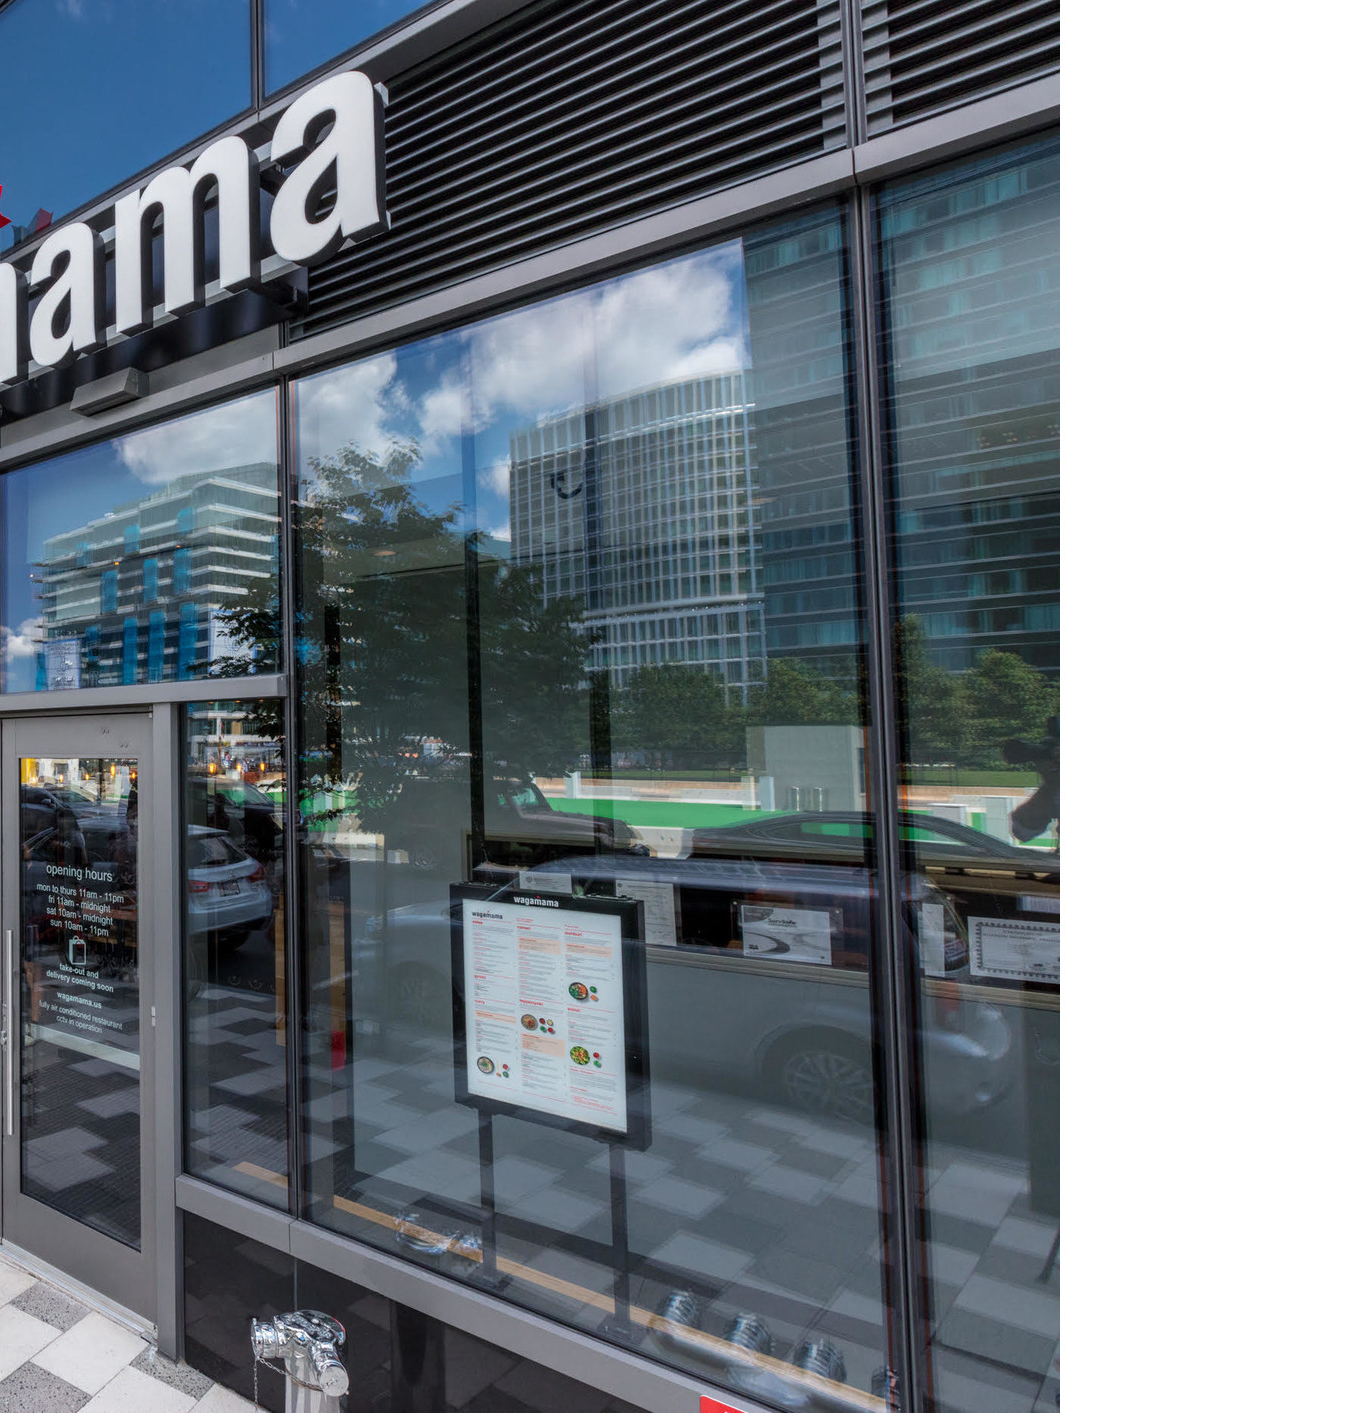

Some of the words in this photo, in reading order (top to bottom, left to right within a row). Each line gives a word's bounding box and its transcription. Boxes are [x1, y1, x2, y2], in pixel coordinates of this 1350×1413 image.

[47, 865, 82, 880] opening
[86, 867, 113, 882] hours
[37, 883, 50, 892] mon
[52, 885, 59, 893] to
[60, 886, 77, 896] thurs
[79, 889, 98, 899] 11am
[105, 892, 124, 904] 11pm
[514, 896, 559, 907] wagamama
[57, 896, 75, 907] 11am
[81, 902, 110, 914] midnight
[47, 907, 56, 915] sat
[59, 908, 77, 919] 10am
[83, 914, 113, 926] midnight
[472, 911, 503, 920] wagamama
[50, 919, 62, 927] sun
[64, 921, 83, 931] 10am
[90, 925, 109, 937] 11pm
[60, 963, 85, 976] take-out
[87, 970, 98, 979] and
[46, 970, 71, 983] delivery
[72, 978, 95, 990] coming
[97, 983, 114, 993] soon
[57, 992, 102, 1009] wagamama.us
[39, 1000, 50, 1010] fully
[59, 1007, 91, 1021] conditioned
[92, 1016, 123, 1030] restaurant
[56, 1015, 68, 1024] cctv
[75, 1020, 103, 1034] operation
